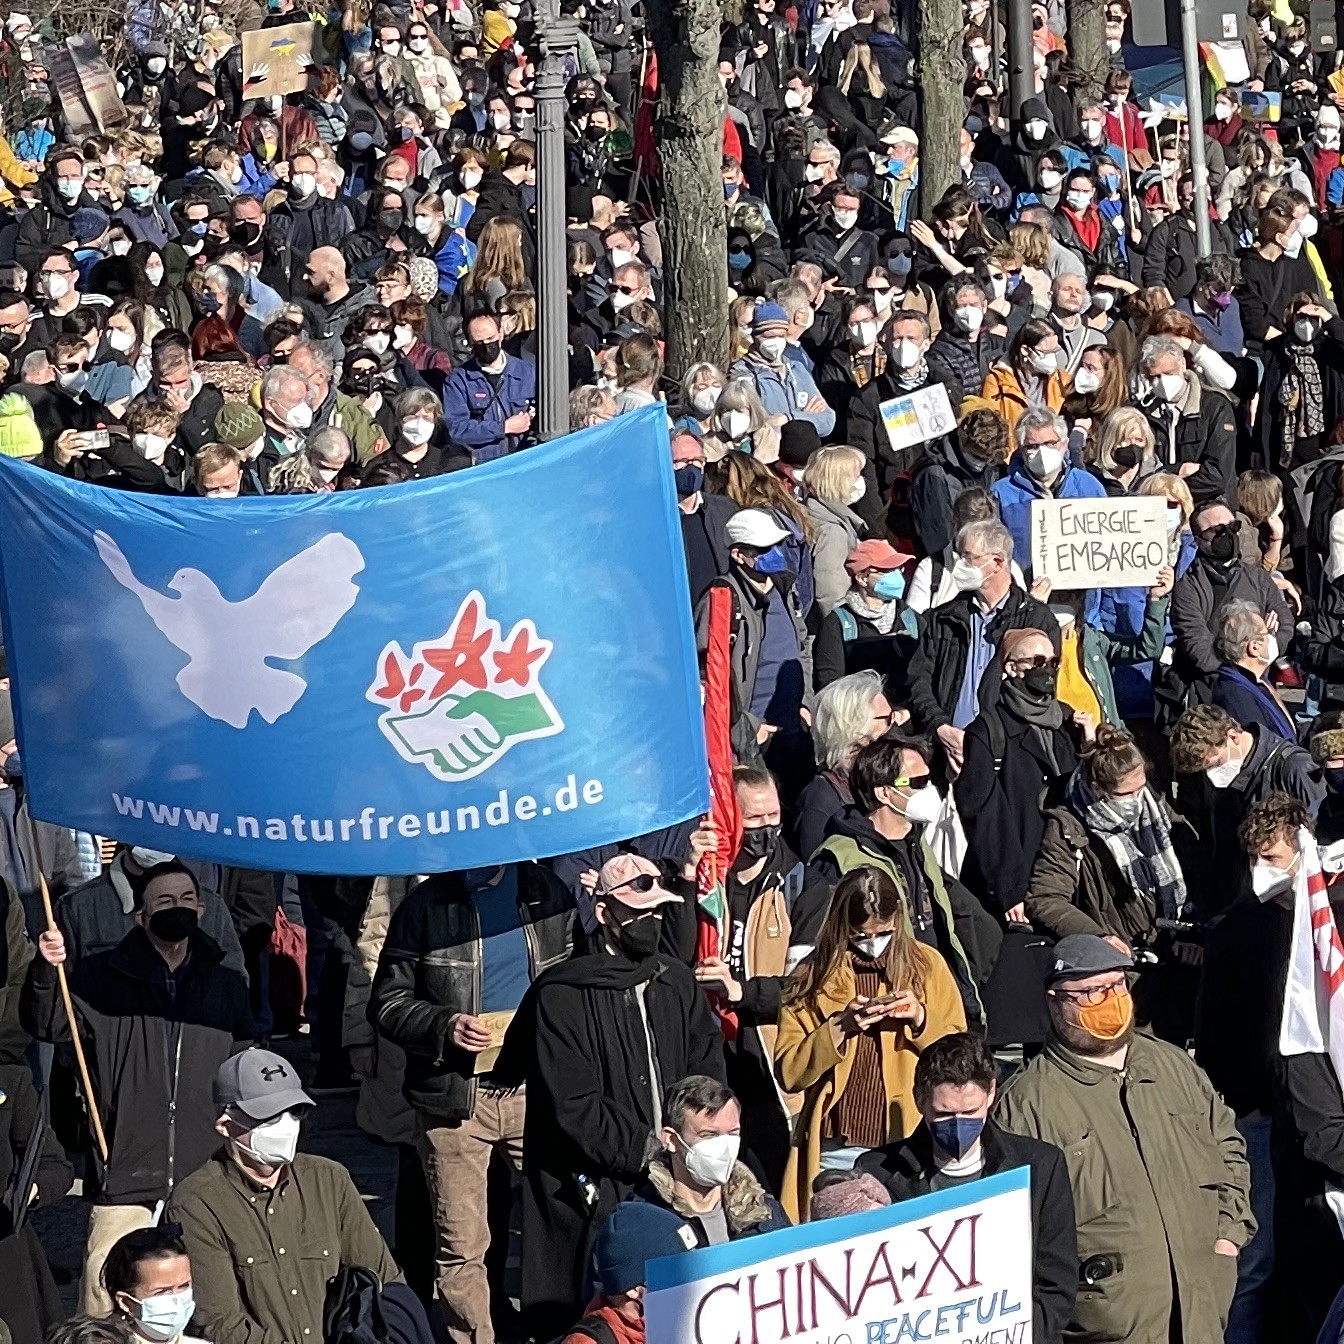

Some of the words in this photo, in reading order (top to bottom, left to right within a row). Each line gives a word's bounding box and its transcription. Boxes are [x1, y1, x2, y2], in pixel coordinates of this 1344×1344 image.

[1056, 540, 1163, 572] EMBARGO
[111, 773, 605, 843] www.naturfreunde.de
[864, 1289, 1022, 1344] PEACEFUL
